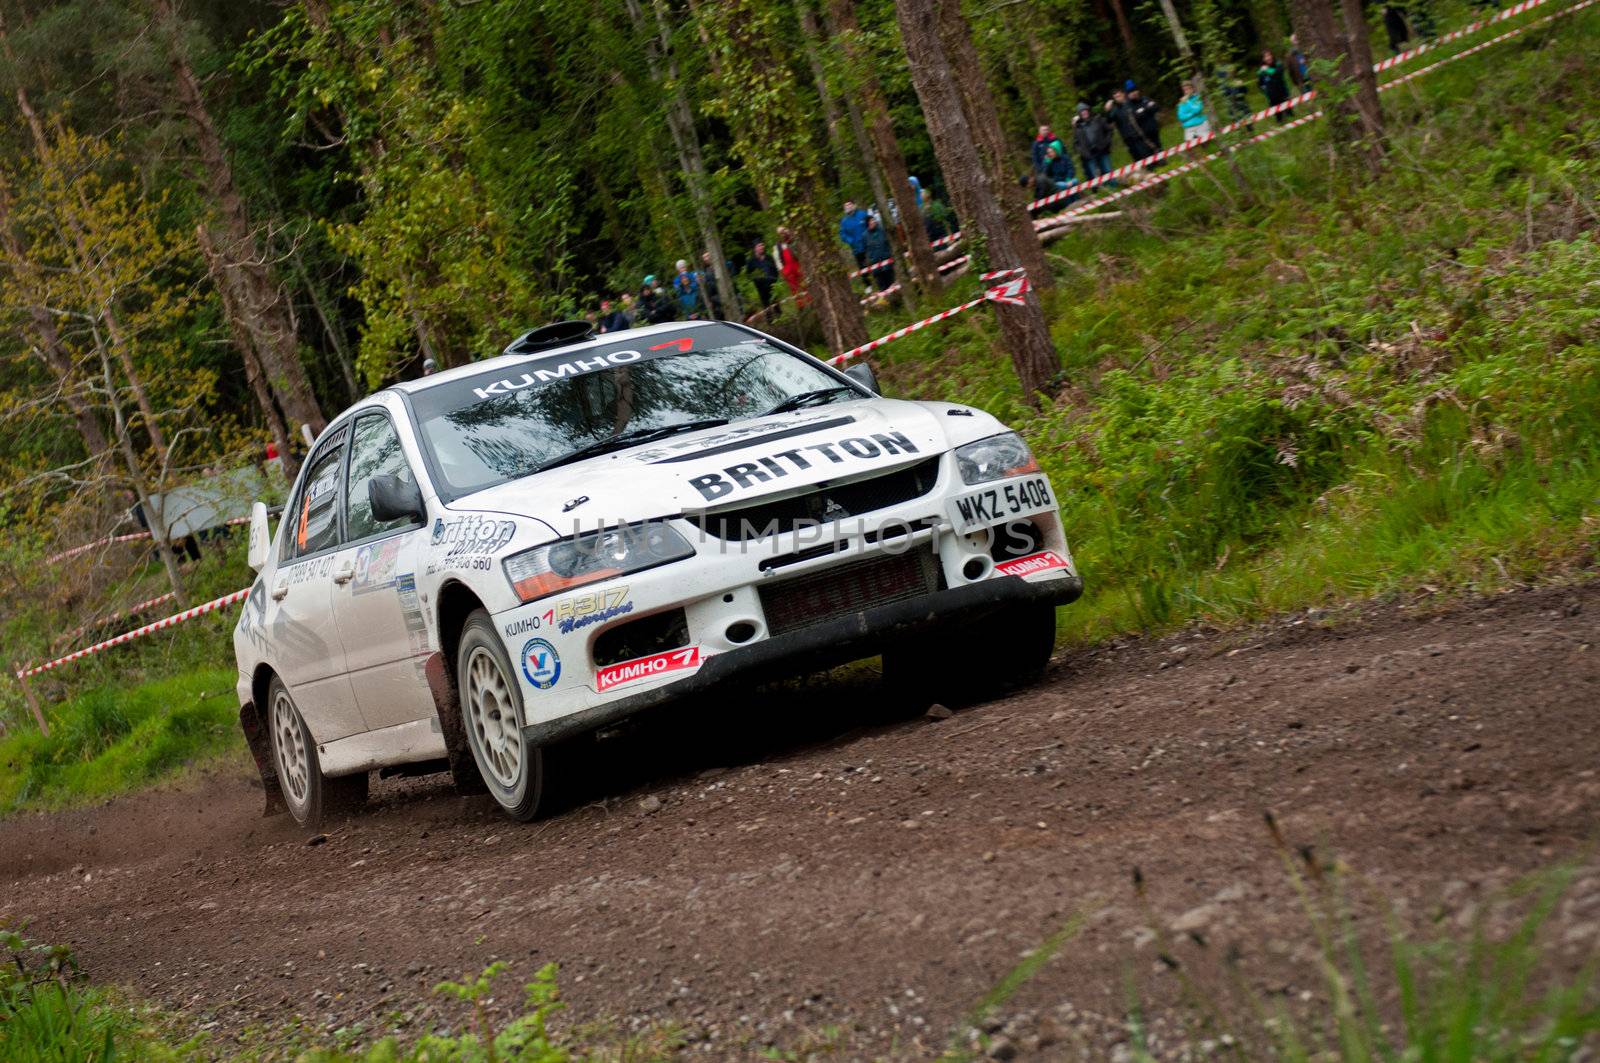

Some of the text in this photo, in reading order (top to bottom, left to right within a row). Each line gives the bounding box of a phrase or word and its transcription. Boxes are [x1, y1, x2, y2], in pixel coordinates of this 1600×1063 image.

[473, 350, 641, 399] KUMHO
[688, 431, 920, 501] BRITTON
[956, 478, 1051, 522] WKZ 5408
[431, 515, 517, 546] britton
[505, 616, 540, 637] KUMHO
[602, 658, 668, 687] KUMHO
